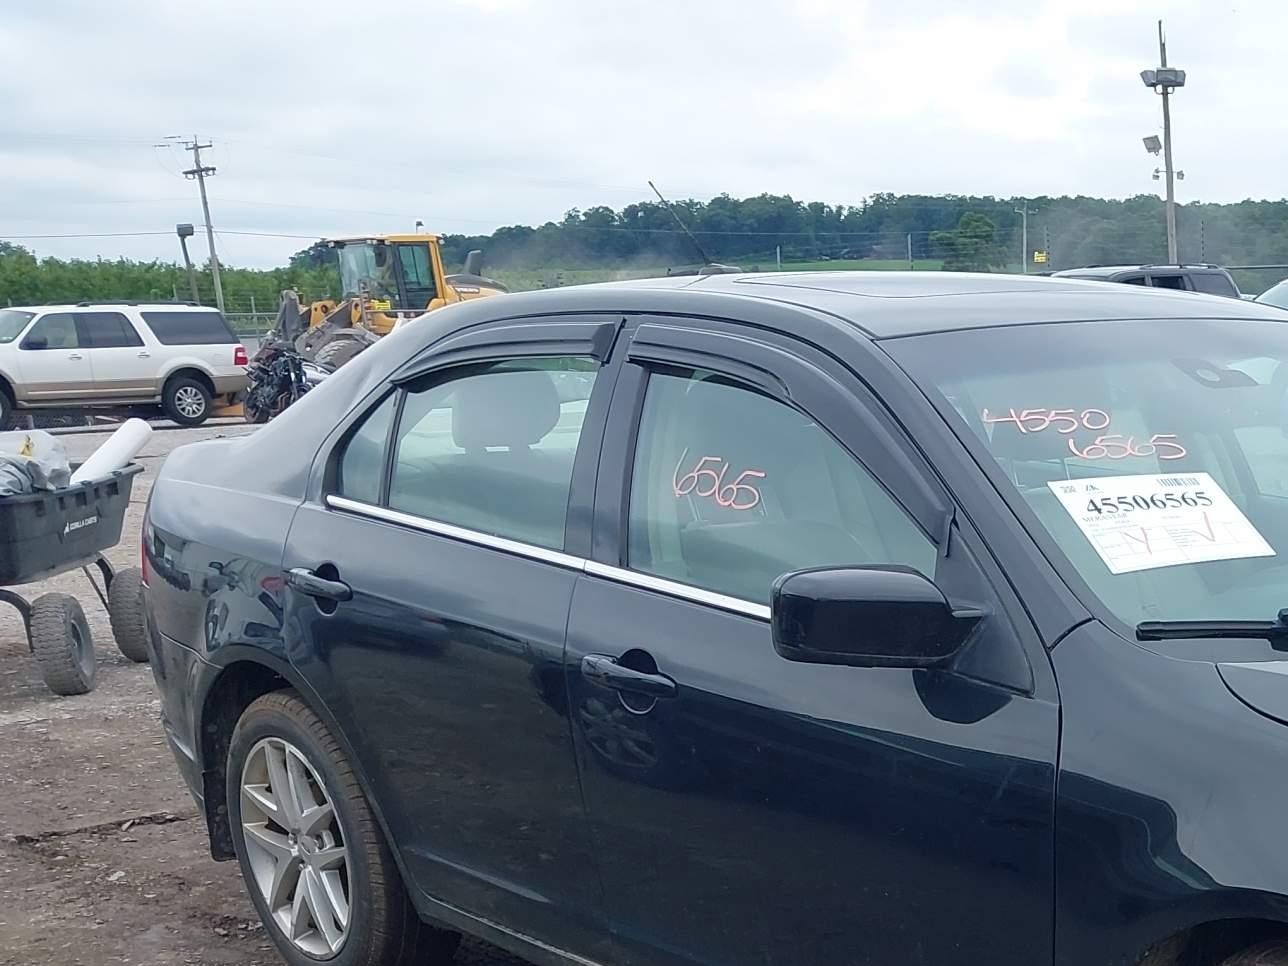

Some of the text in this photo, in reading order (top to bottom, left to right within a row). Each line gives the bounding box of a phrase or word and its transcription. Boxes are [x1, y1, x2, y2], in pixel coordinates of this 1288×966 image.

[982, 407, 1111, 434] 4550
[1068, 434, 1187, 460] 6565
[672, 447, 766, 510] 6565
[1086, 491, 1213, 515] 45506565
